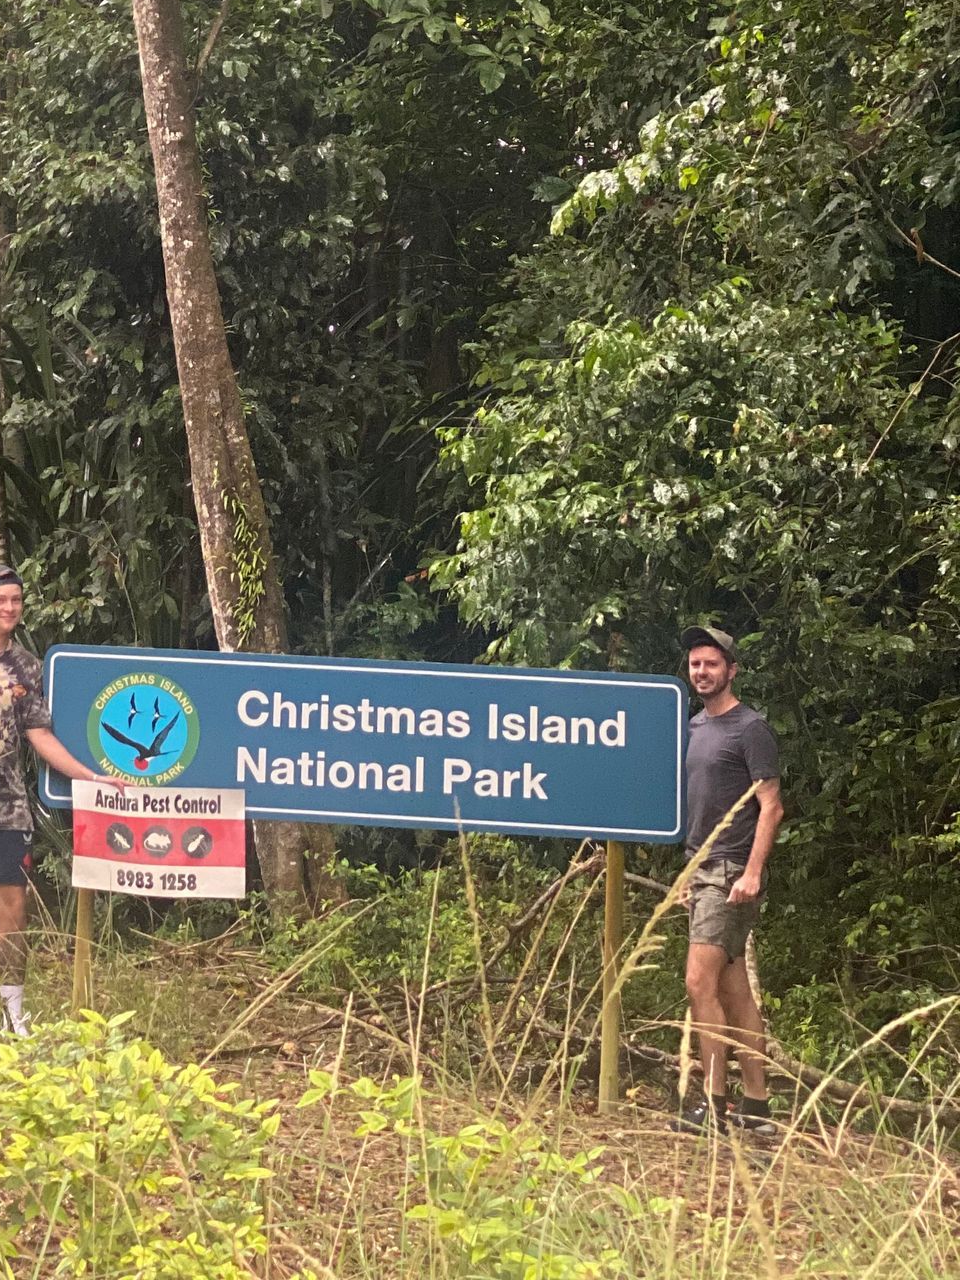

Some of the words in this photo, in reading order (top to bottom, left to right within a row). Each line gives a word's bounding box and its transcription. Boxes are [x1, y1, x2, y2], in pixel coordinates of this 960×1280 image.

[95, 675, 155, 710] CHRISTMAS
[159, 679, 193, 715] ISLAND
[237, 690, 471, 738] Christmas
[489, 704, 626, 747] Island
[156, 762, 185, 785] PARK
[236, 746, 424, 792] National
[444, 758, 548, 800] Park
[95, 790, 138, 812] Arafura
[143, 796, 170, 813] Pest
[174, 796, 221, 814] Control
[117, 869, 154, 888] 8983
[160, 873, 196, 890] 1258
